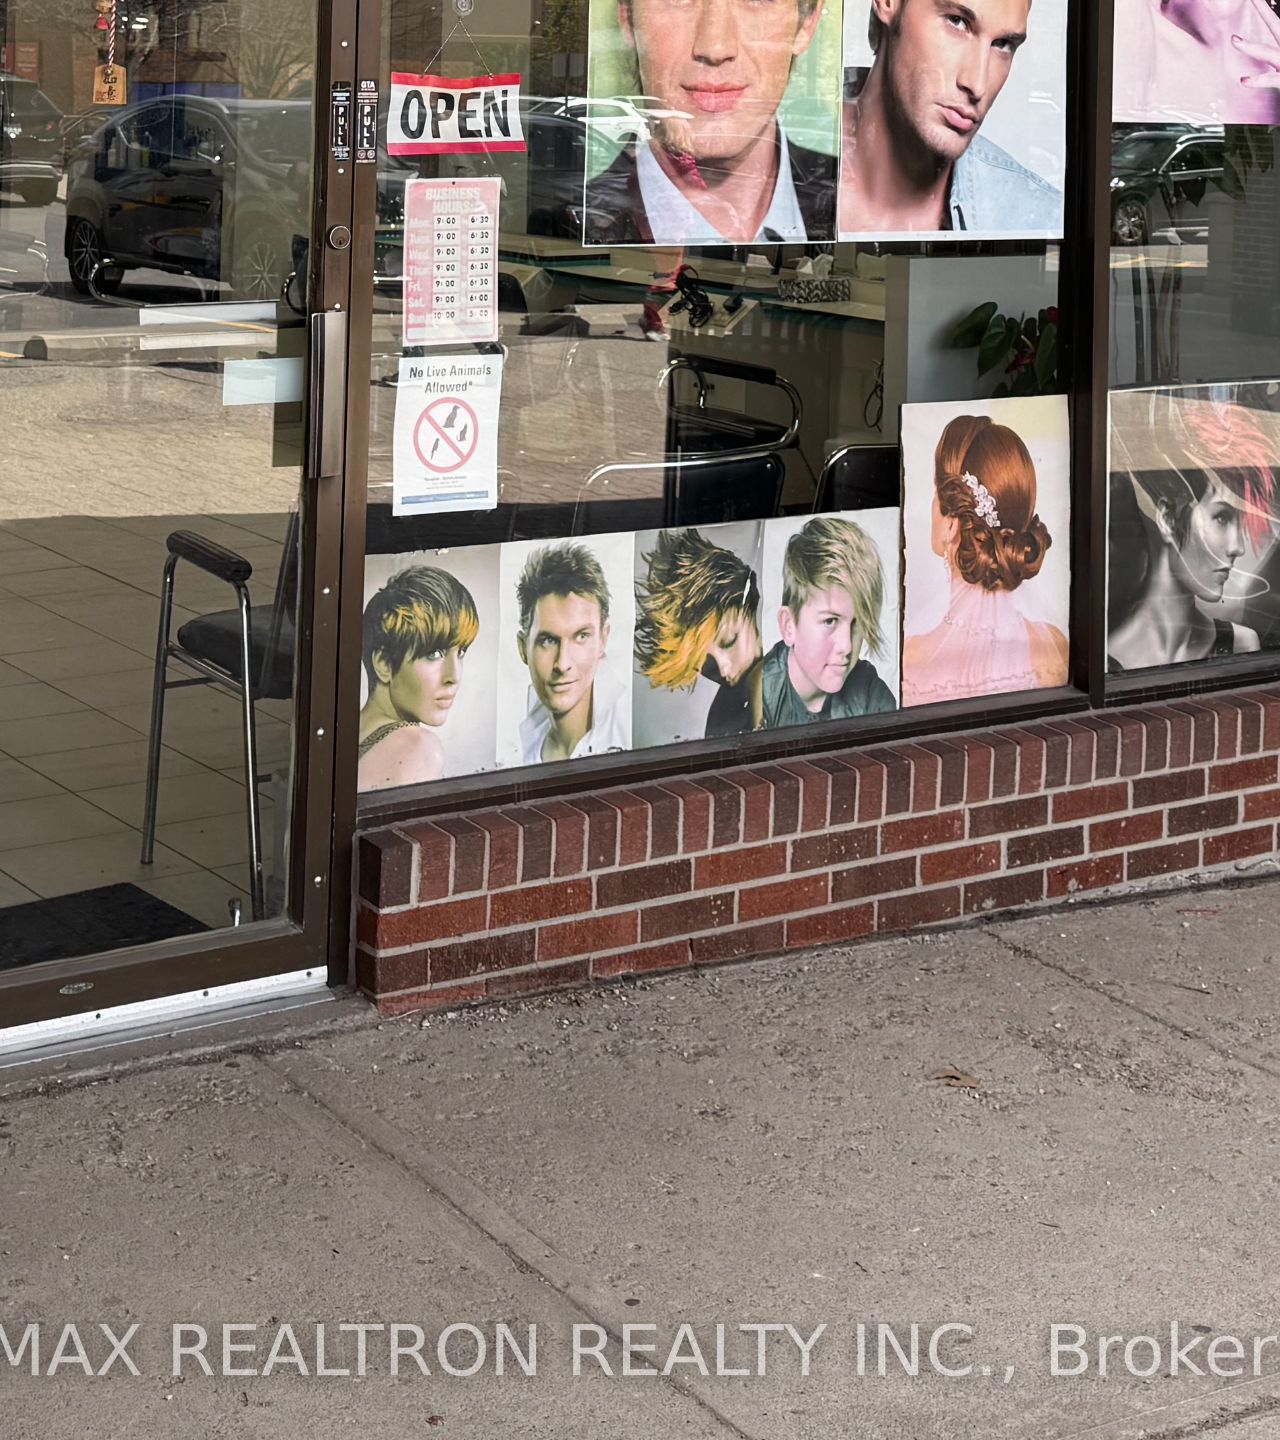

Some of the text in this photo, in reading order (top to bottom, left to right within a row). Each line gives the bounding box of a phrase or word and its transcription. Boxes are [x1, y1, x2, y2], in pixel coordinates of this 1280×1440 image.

[363, 106, 371, 147] PULL
[399, 89, 510, 140] OPEN
[425, 187, 481, 200] BUSINESS
[409, 364, 491, 378] No Live Animals
